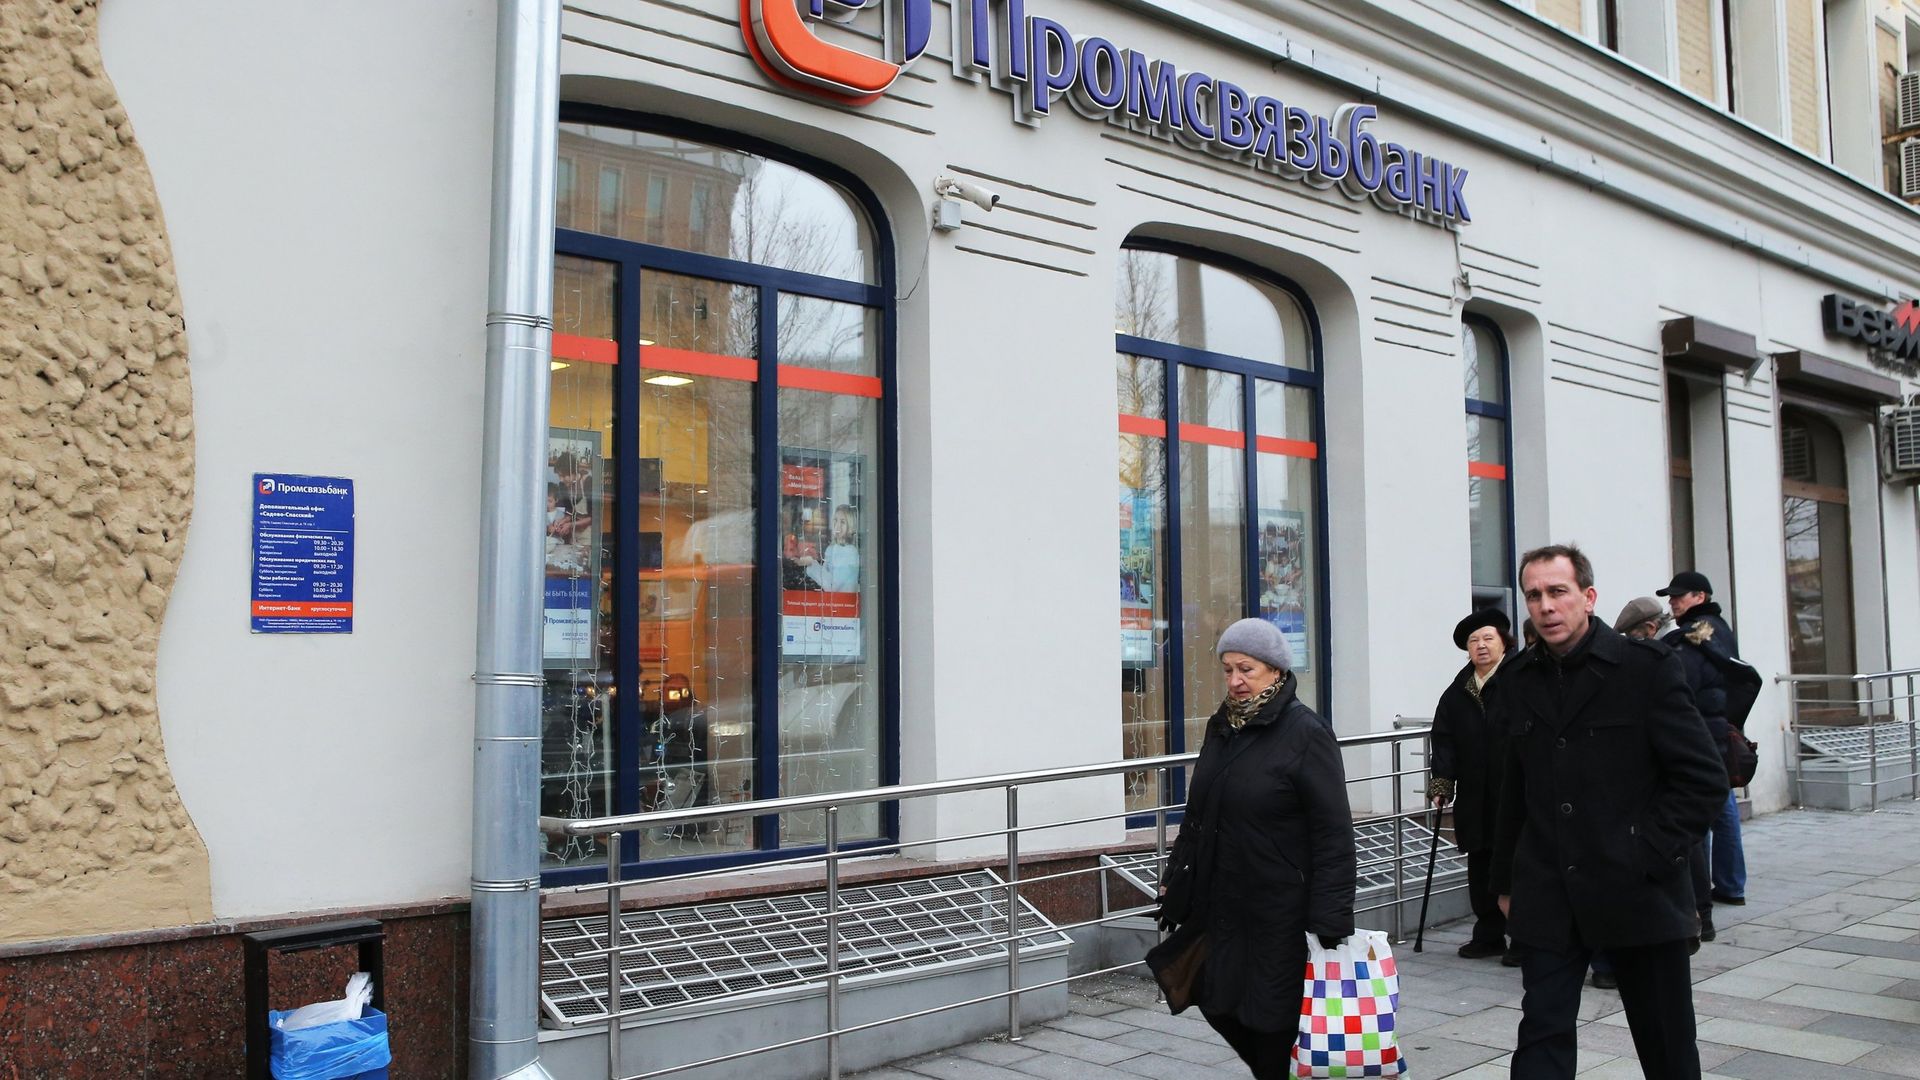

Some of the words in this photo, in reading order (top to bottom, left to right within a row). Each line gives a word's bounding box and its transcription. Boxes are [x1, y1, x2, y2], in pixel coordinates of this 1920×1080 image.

[964, 0, 1471, 226] Промсвязьбанк
[277, 482, 348, 495] Промсвязьбанк
[310, 505, 325, 513] офис
